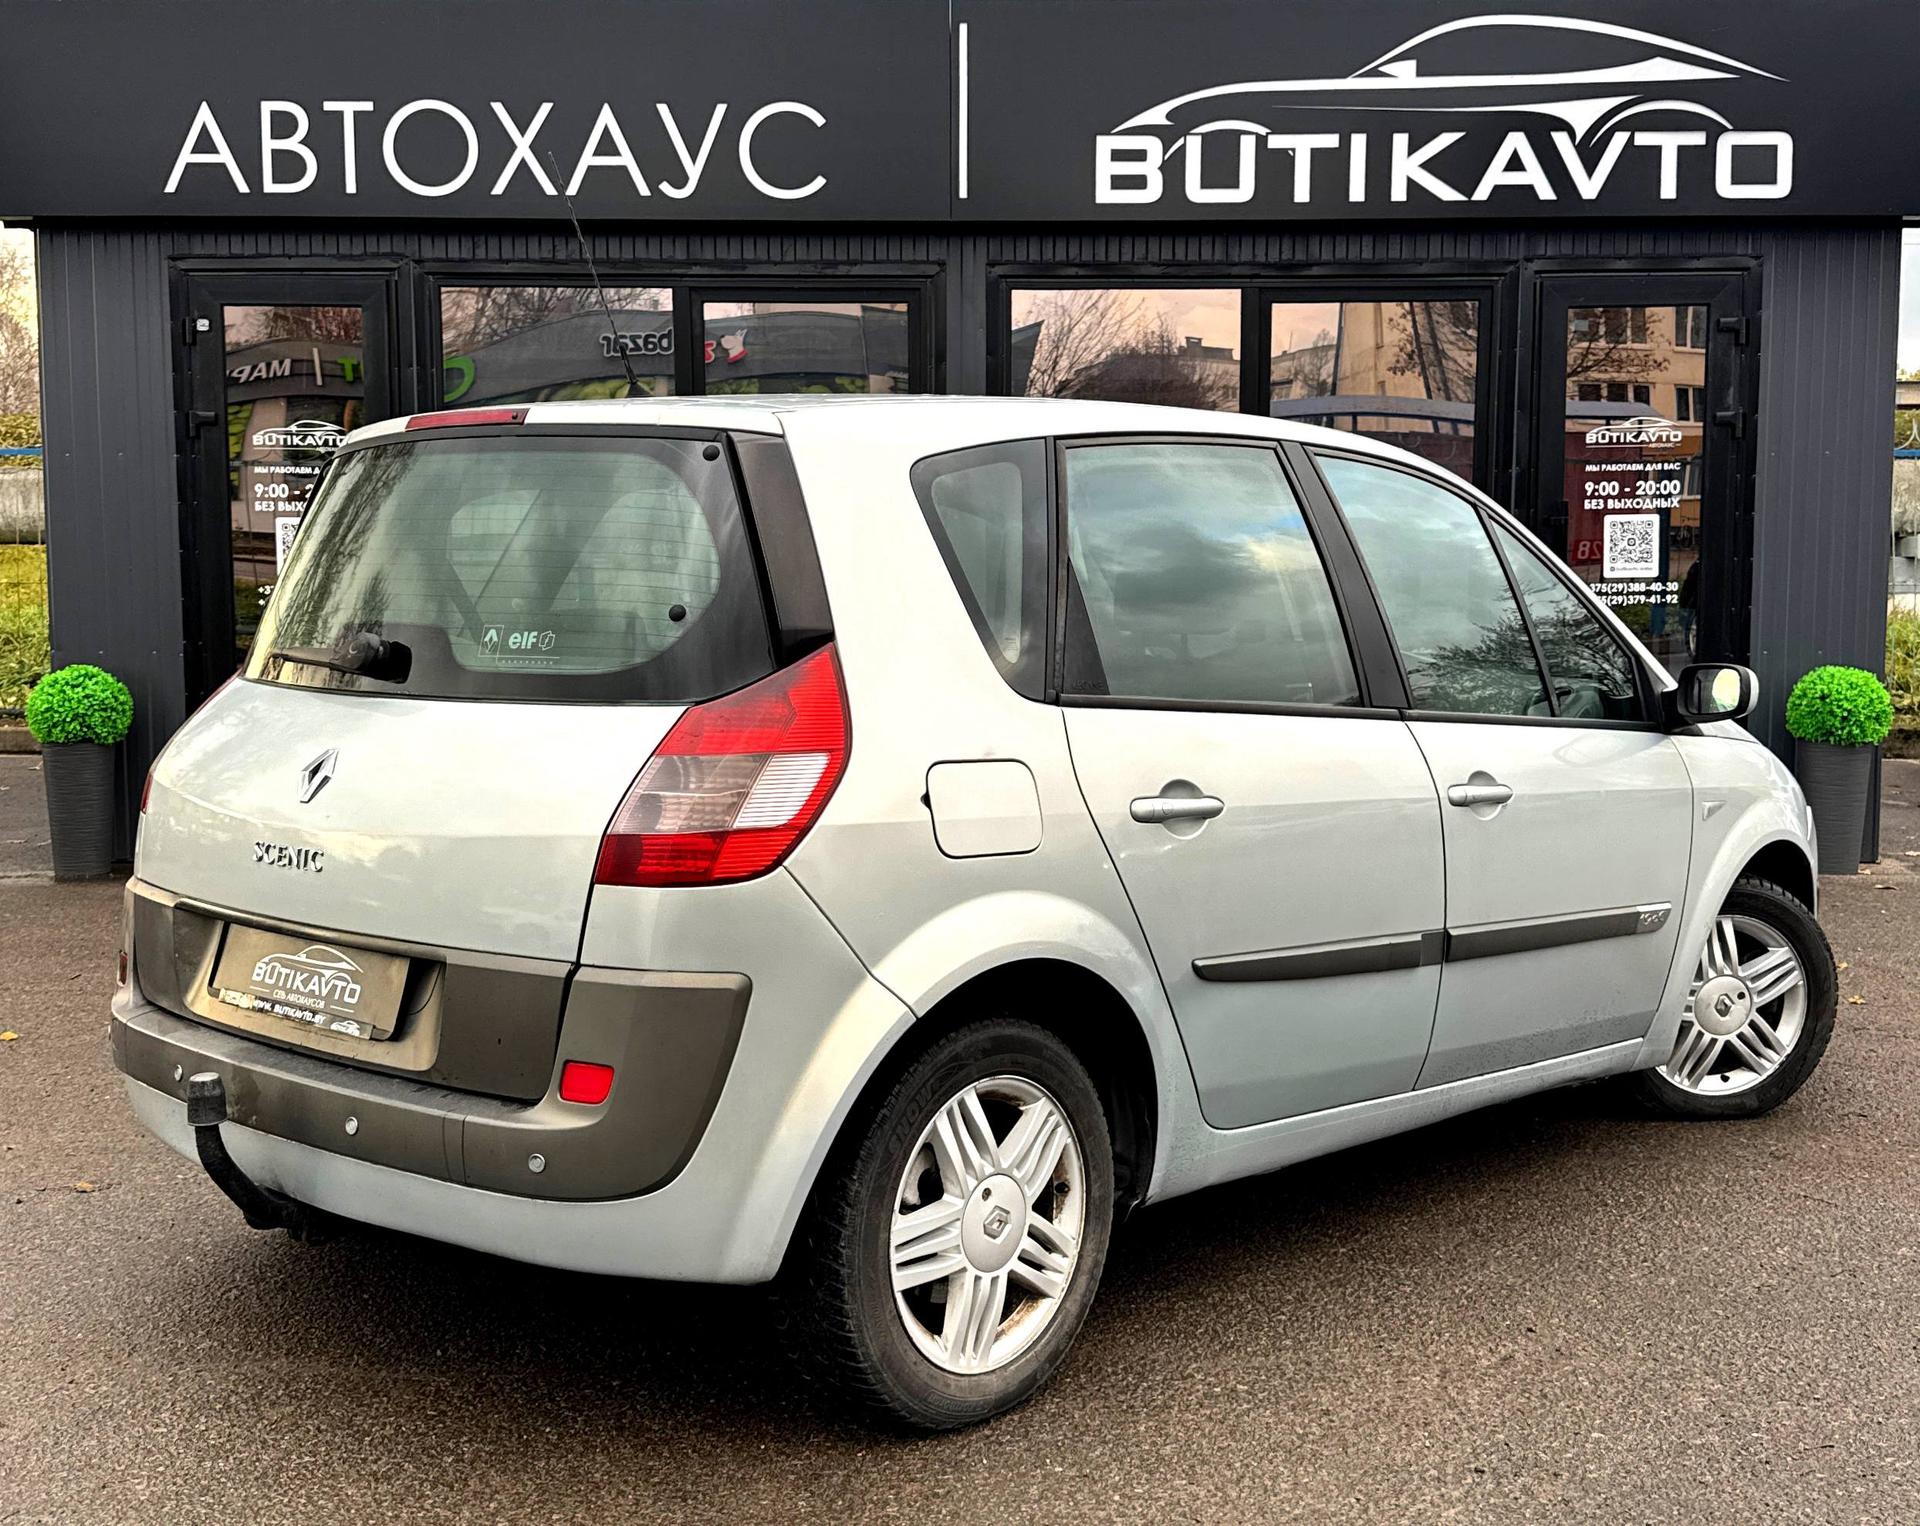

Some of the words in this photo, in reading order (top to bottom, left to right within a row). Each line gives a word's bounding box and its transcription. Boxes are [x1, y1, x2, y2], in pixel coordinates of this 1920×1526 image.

[164, 98, 828, 199] АВТОХАУС
[1095, 130, 1794, 204] BUTIKAVTO
[1585, 431, 1682, 444] BUTIKAVTO
[270, 466, 312, 474] РАБОТАЕМ
[1601, 464, 1644, 472] РАБОТАЕМ
[1645, 463, 1662, 471] ДЛЯ
[1663, 463, 1681, 471] ВАС
[254, 483, 289, 499] 9:00
[1584, 481, 1620, 496] 9:00
[1635, 480, 1681, 496] 20:00
[254, 501, 275, 512] БЕЗ
[1584, 499, 1605, 510] БЕЗ
[1607, 498, 1680, 509] ВЫХОДНЫХ
[508, 631, 538, 649] elf
[253, 841, 325, 873] SCENIC
[251, 961, 361, 1004] BUTIKAVTO
